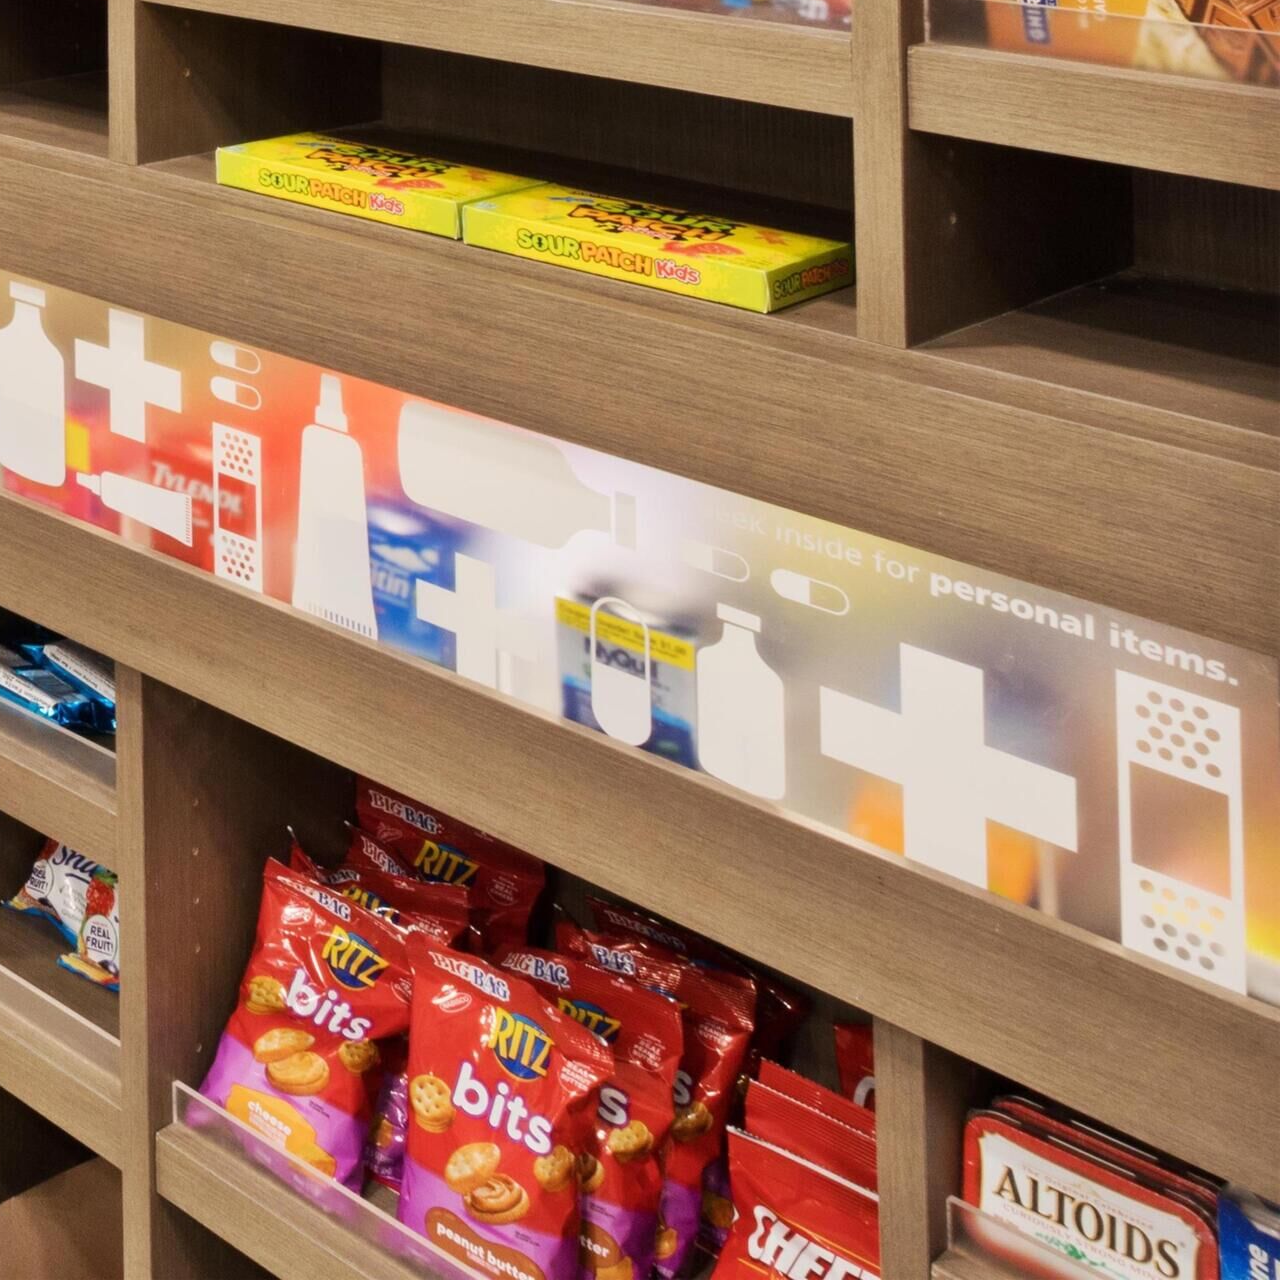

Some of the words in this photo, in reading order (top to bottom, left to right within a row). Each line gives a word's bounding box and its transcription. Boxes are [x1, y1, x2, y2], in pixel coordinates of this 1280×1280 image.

[258, 167, 310, 197] SOUR
[309, 179, 367, 209] PATCH
[514, 227, 582, 261] SOUR
[581, 239, 653, 276] PATCH
[774, 524, 864, 567] inside
[874, 543, 921, 584] for
[929, 571, 1096, 643] personal
[1108, 620, 1242, 688] items.
[368, 788, 403, 818] BIG
[402, 805, 439, 835] BAG
[413, 838, 481, 886] RITZ
[317, 891, 352, 923] BAG
[90, 924, 113, 942] REAL
[321, 924, 391, 988] RITZ
[428, 950, 471, 983] BIG
[469, 965, 511, 1002] BAG
[530, 956, 571, 989] BAG
[286, 967, 373, 1042] bits
[488, 1006, 556, 1078] RITZ
[247, 1099, 293, 1137] cheese
[451, 1060, 554, 1157] bits
[435, 1221, 486, 1258] peanut
[991, 1163, 1181, 1280] ALTOIDS
